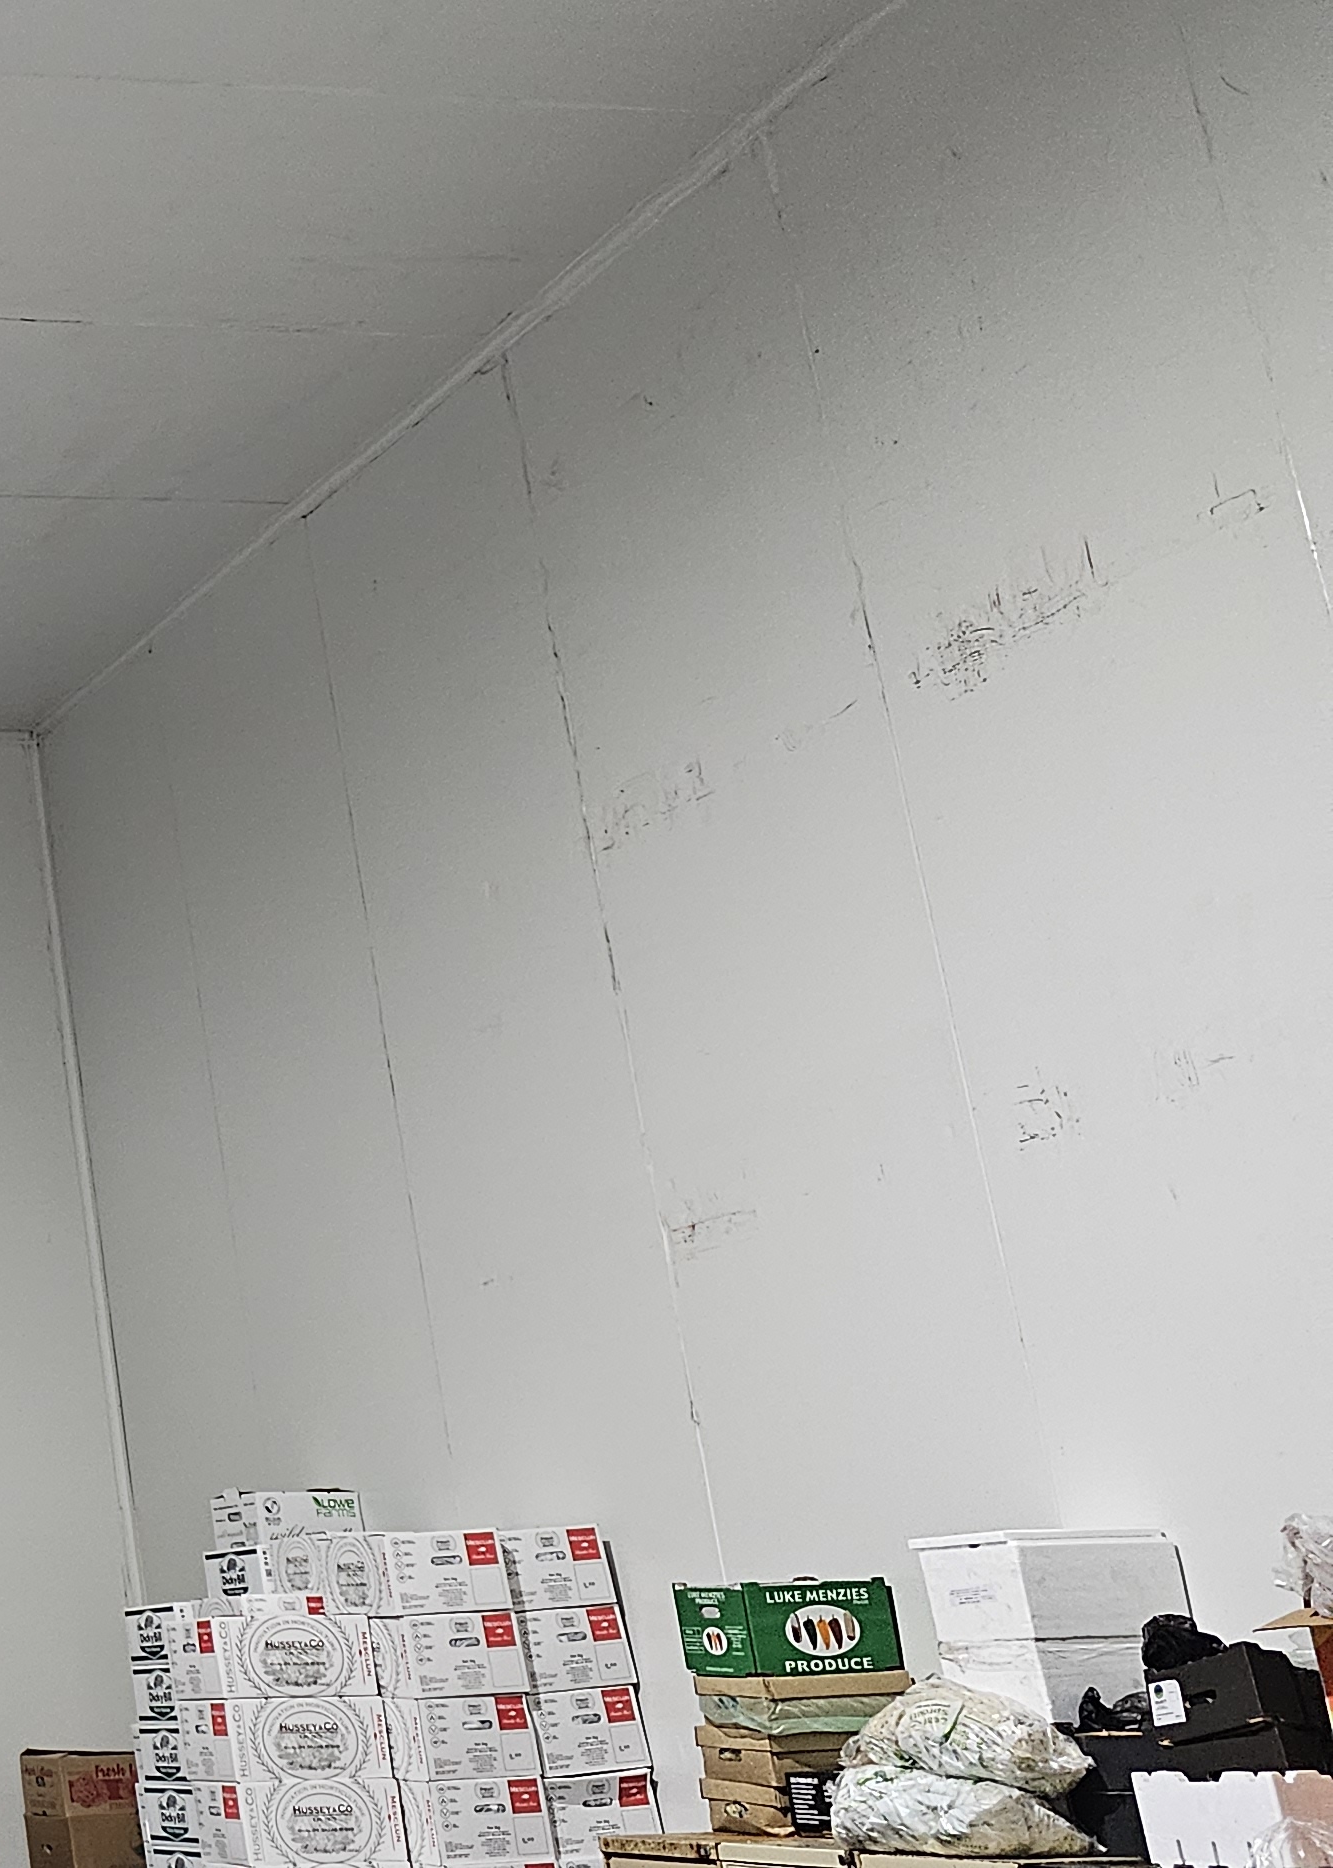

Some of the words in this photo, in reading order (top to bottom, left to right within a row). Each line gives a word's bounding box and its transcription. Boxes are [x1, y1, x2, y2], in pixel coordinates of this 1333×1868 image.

[765, 1590, 803, 1604] LUKE
[806, 1588, 869, 1602] MENZIES
[361, 1631, 372, 1677] MESCLUN
[785, 1657, 874, 1673] PRODUCE
[376, 1713, 387, 1761] MESCLUN
[94, 1763, 126, 1778] Fresh
[390, 1795, 402, 1843] MESCLUN
